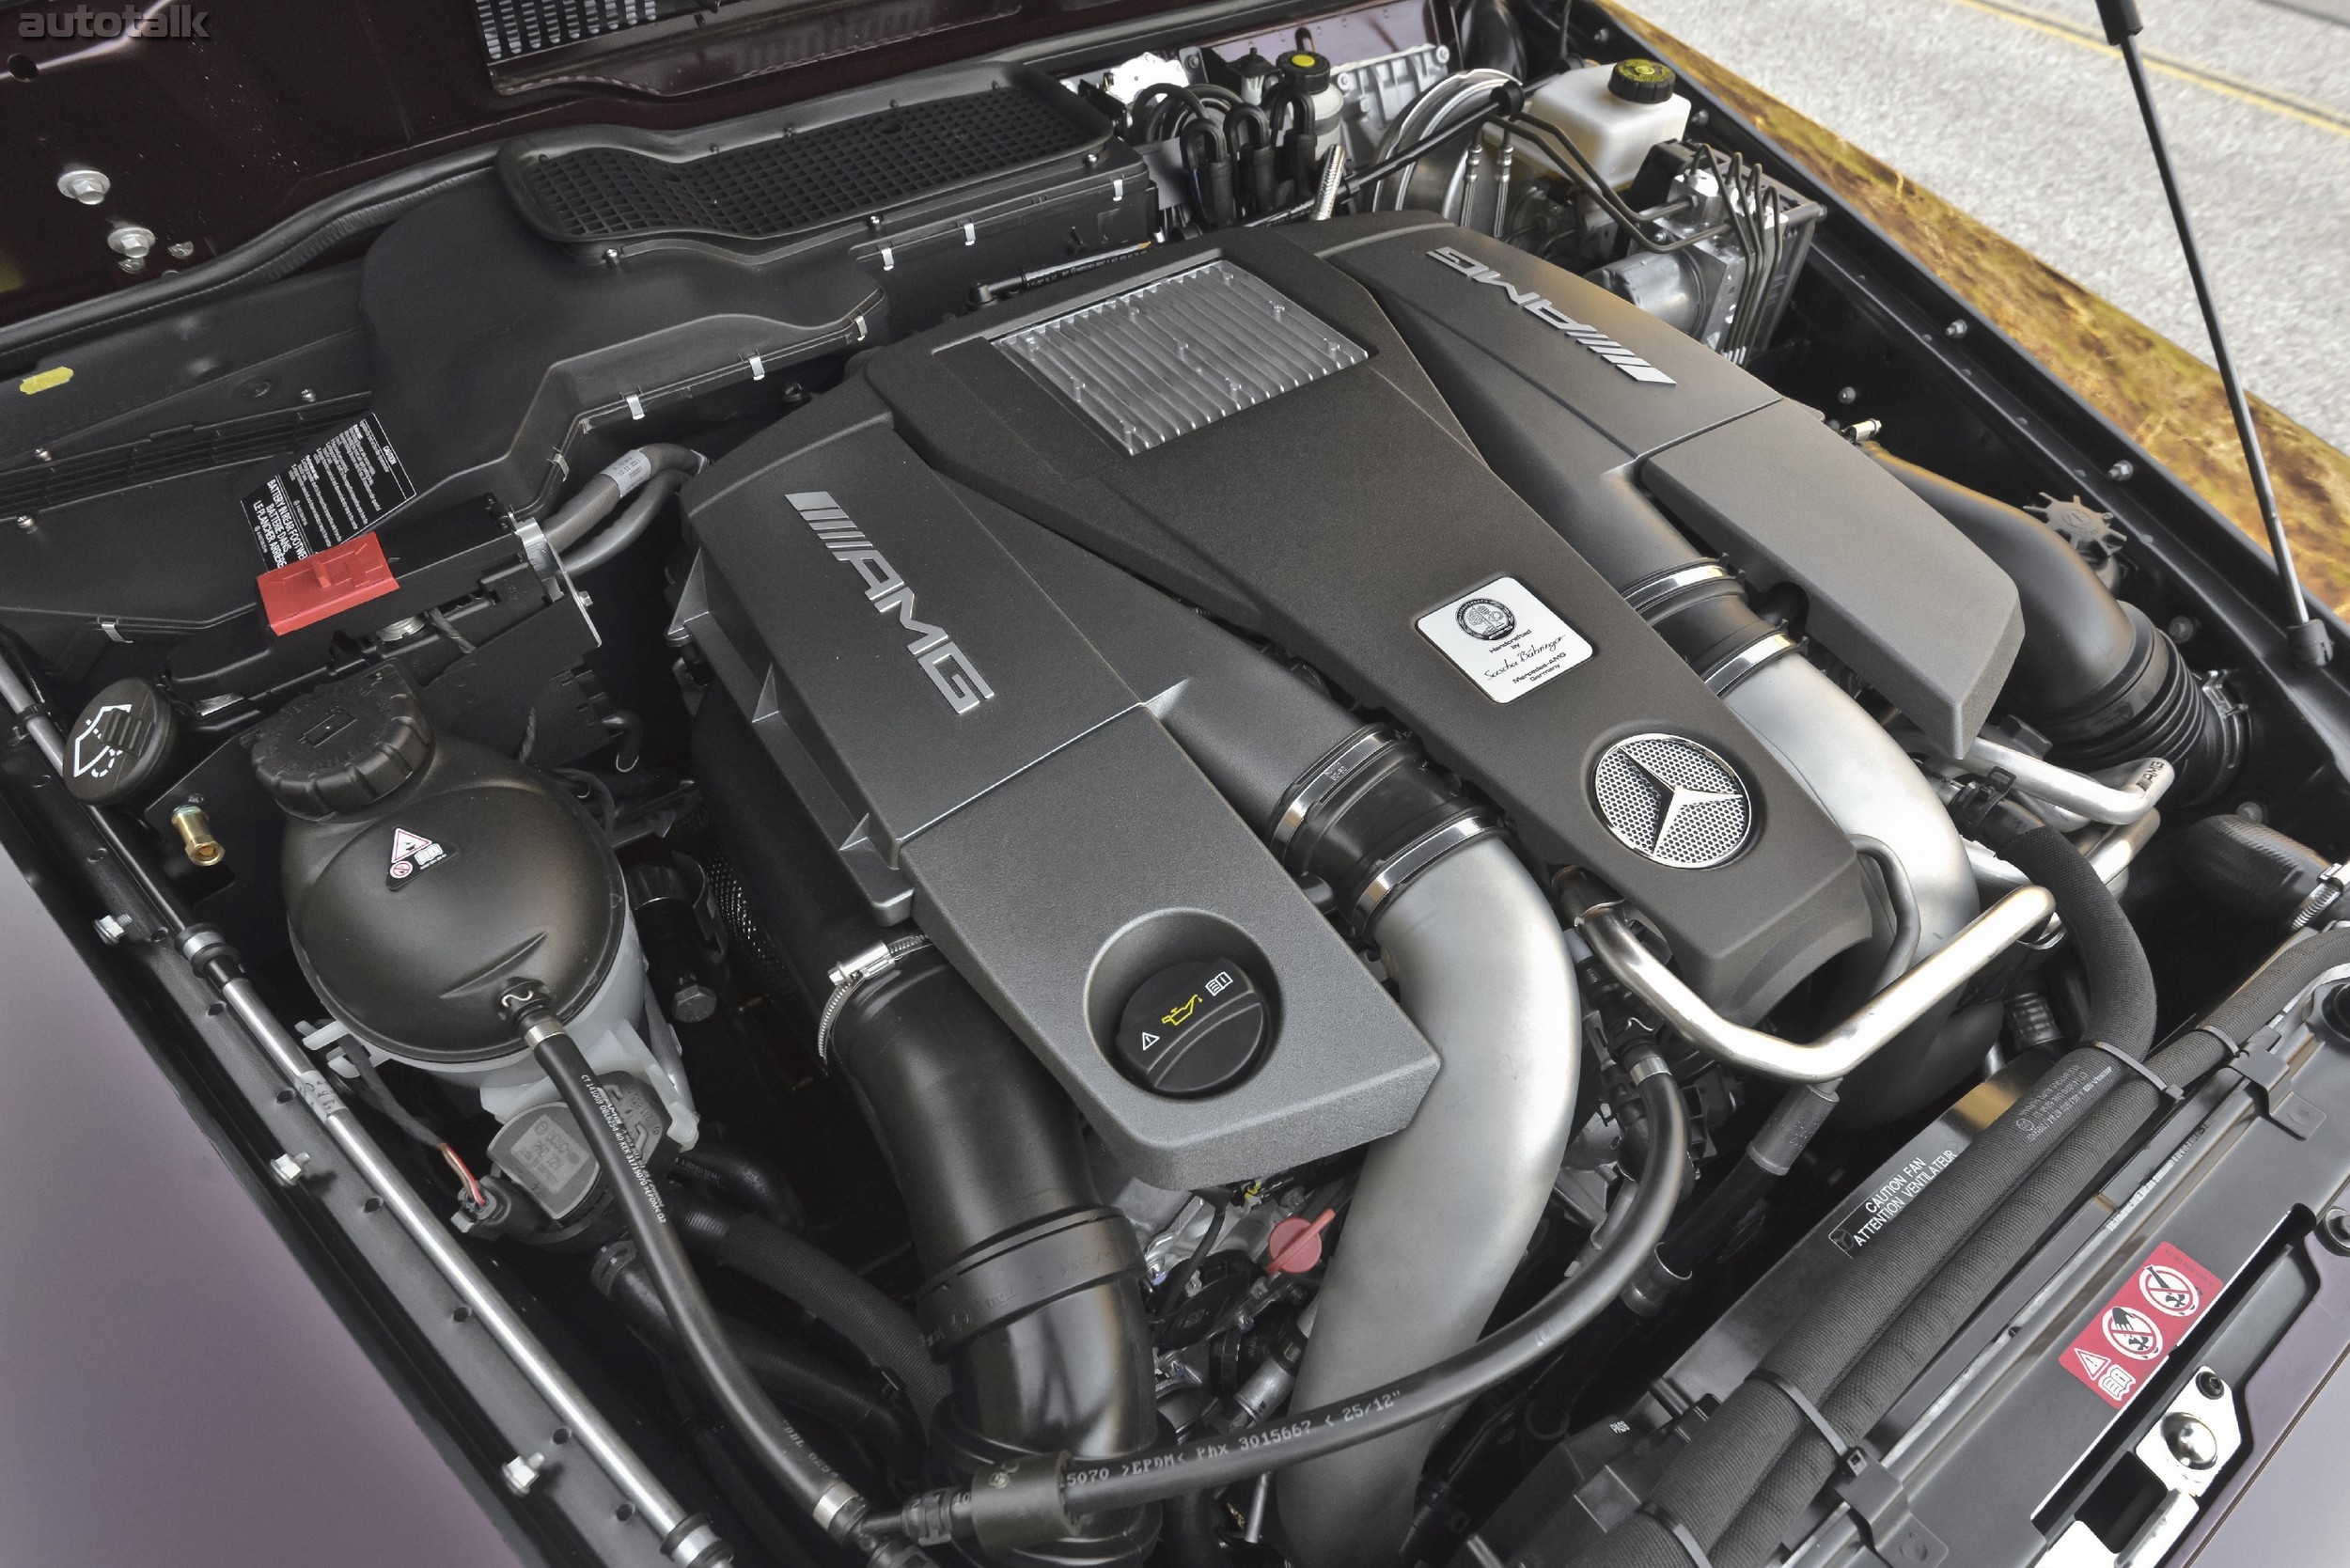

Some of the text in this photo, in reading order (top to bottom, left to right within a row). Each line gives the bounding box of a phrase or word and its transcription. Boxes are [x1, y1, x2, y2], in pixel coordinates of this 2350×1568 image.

[383, 446, 397, 464] CAUTION
[253, 500, 263, 511] LE
[267, 478, 286, 507] BATTERY
[256, 508, 275, 542] PLANCHER
[266, 503, 284, 534] BATTERIE
[278, 506, 288, 515] IN
[281, 511, 294, 532] REAR
[832, 549, 995, 715] AMG
[1489, 629, 1532, 653] Handcrafted
[1512, 652, 1566, 683] Mercedes-AMG
[1529, 664, 1560, 682] Germany
[1854, 1150, 1957, 1247] ATTENTION VENTILATEUR
[1865, 1157, 1926, 1213] CAUTION FAN
[1609, 1420, 1630, 1435] PASS
[1060, 1467, 1110, 1489] 5070
[1238, 1420, 1311, 1450] 3015667
